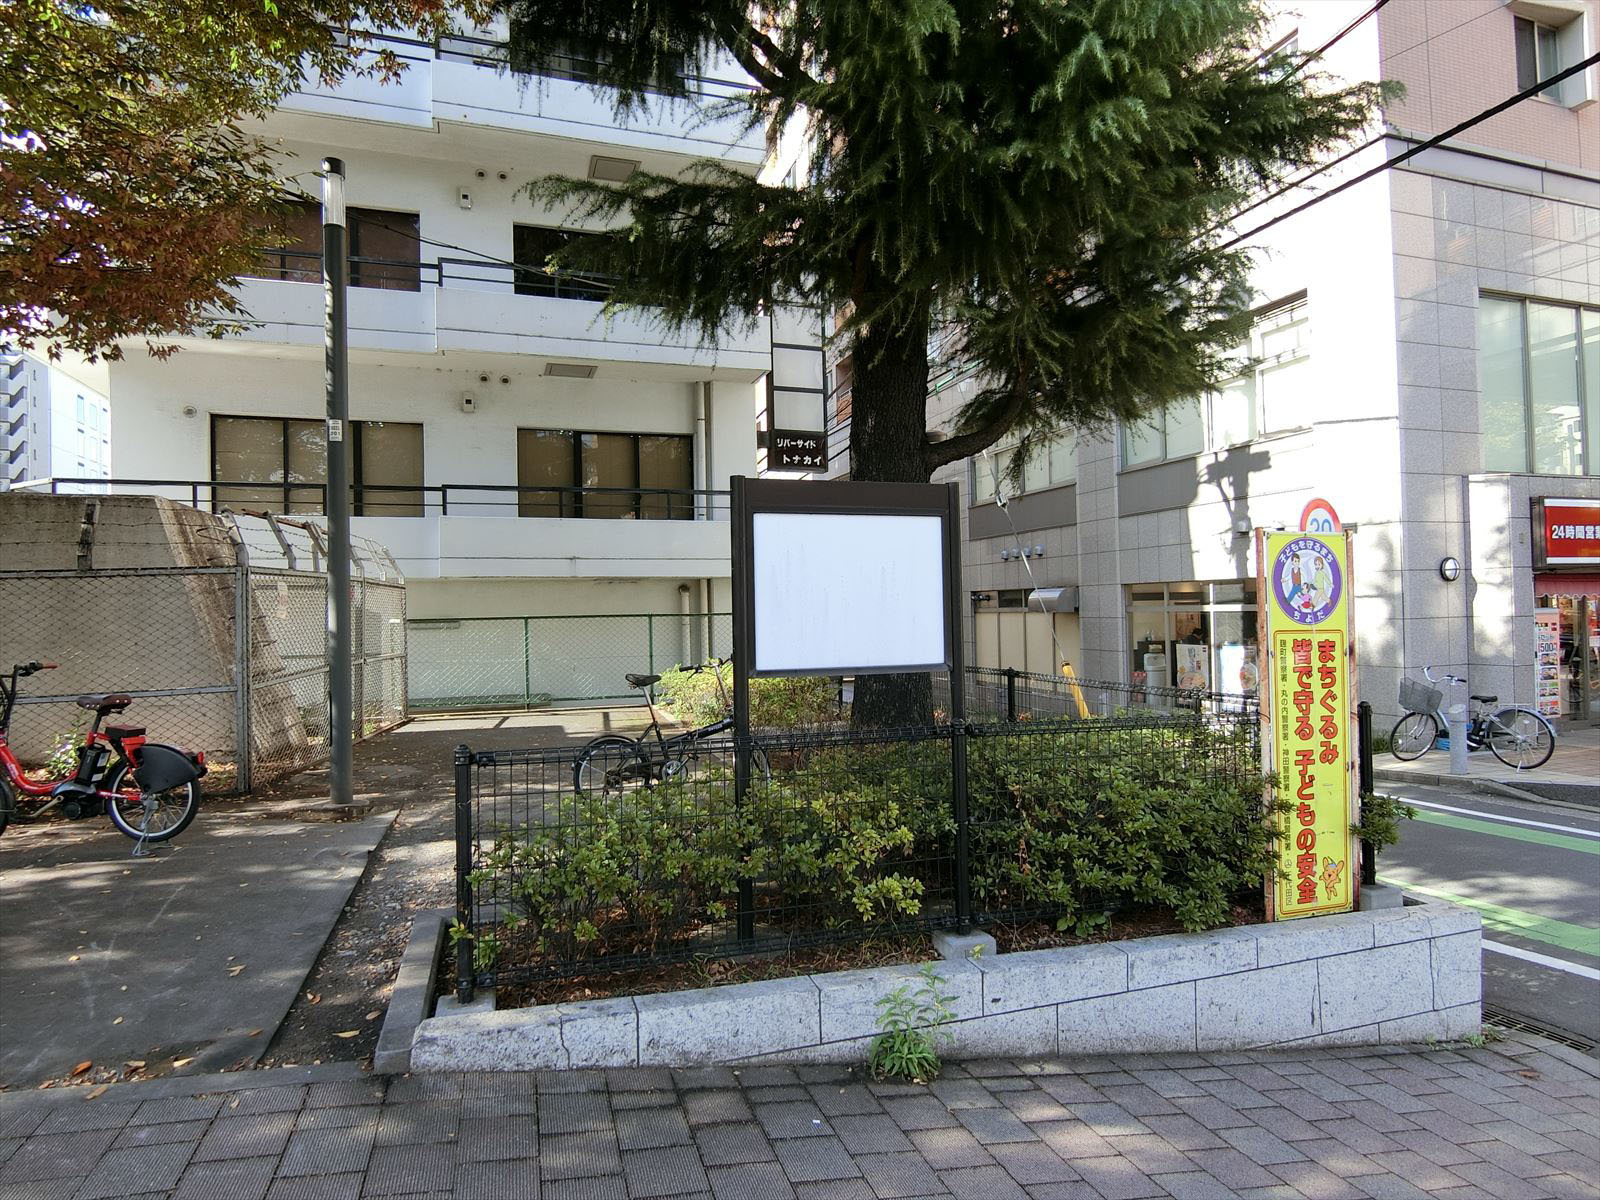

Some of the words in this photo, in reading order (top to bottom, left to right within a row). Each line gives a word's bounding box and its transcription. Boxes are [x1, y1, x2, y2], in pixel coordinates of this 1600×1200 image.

[777, 438, 817, 449] リバーサイド
[783, 454, 822, 466] トナカイ
[1278, 540, 1334, 564] 子どもを守るまち
[1291, 638, 1315, 741] 皆で守る
[1317, 638, 1340, 765] まちぐるみ
[1294, 749, 1319, 905] 子どもの安全
